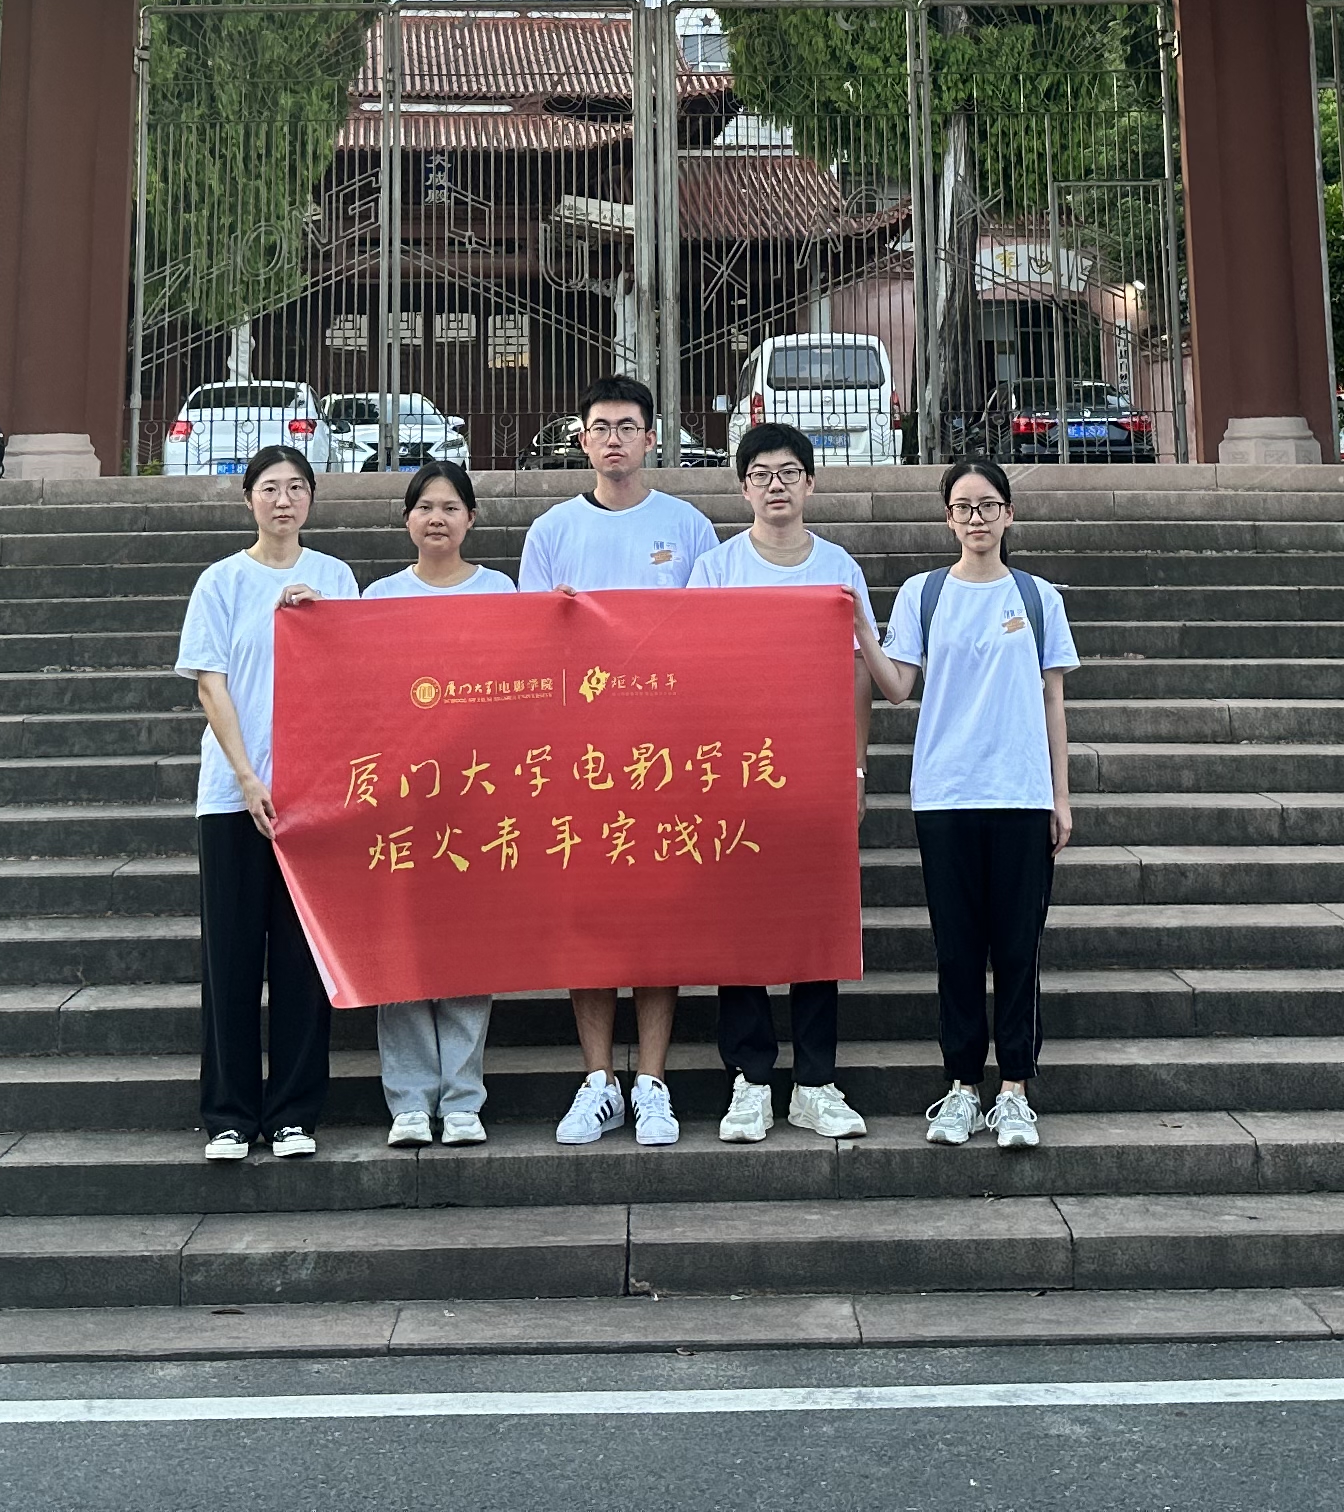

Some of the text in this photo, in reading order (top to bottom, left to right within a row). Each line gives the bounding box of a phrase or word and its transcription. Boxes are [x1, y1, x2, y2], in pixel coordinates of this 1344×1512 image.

[343, 738, 787, 809] 厦门大学电影学院
[368, 810, 761, 873] 炬火青年实践队
